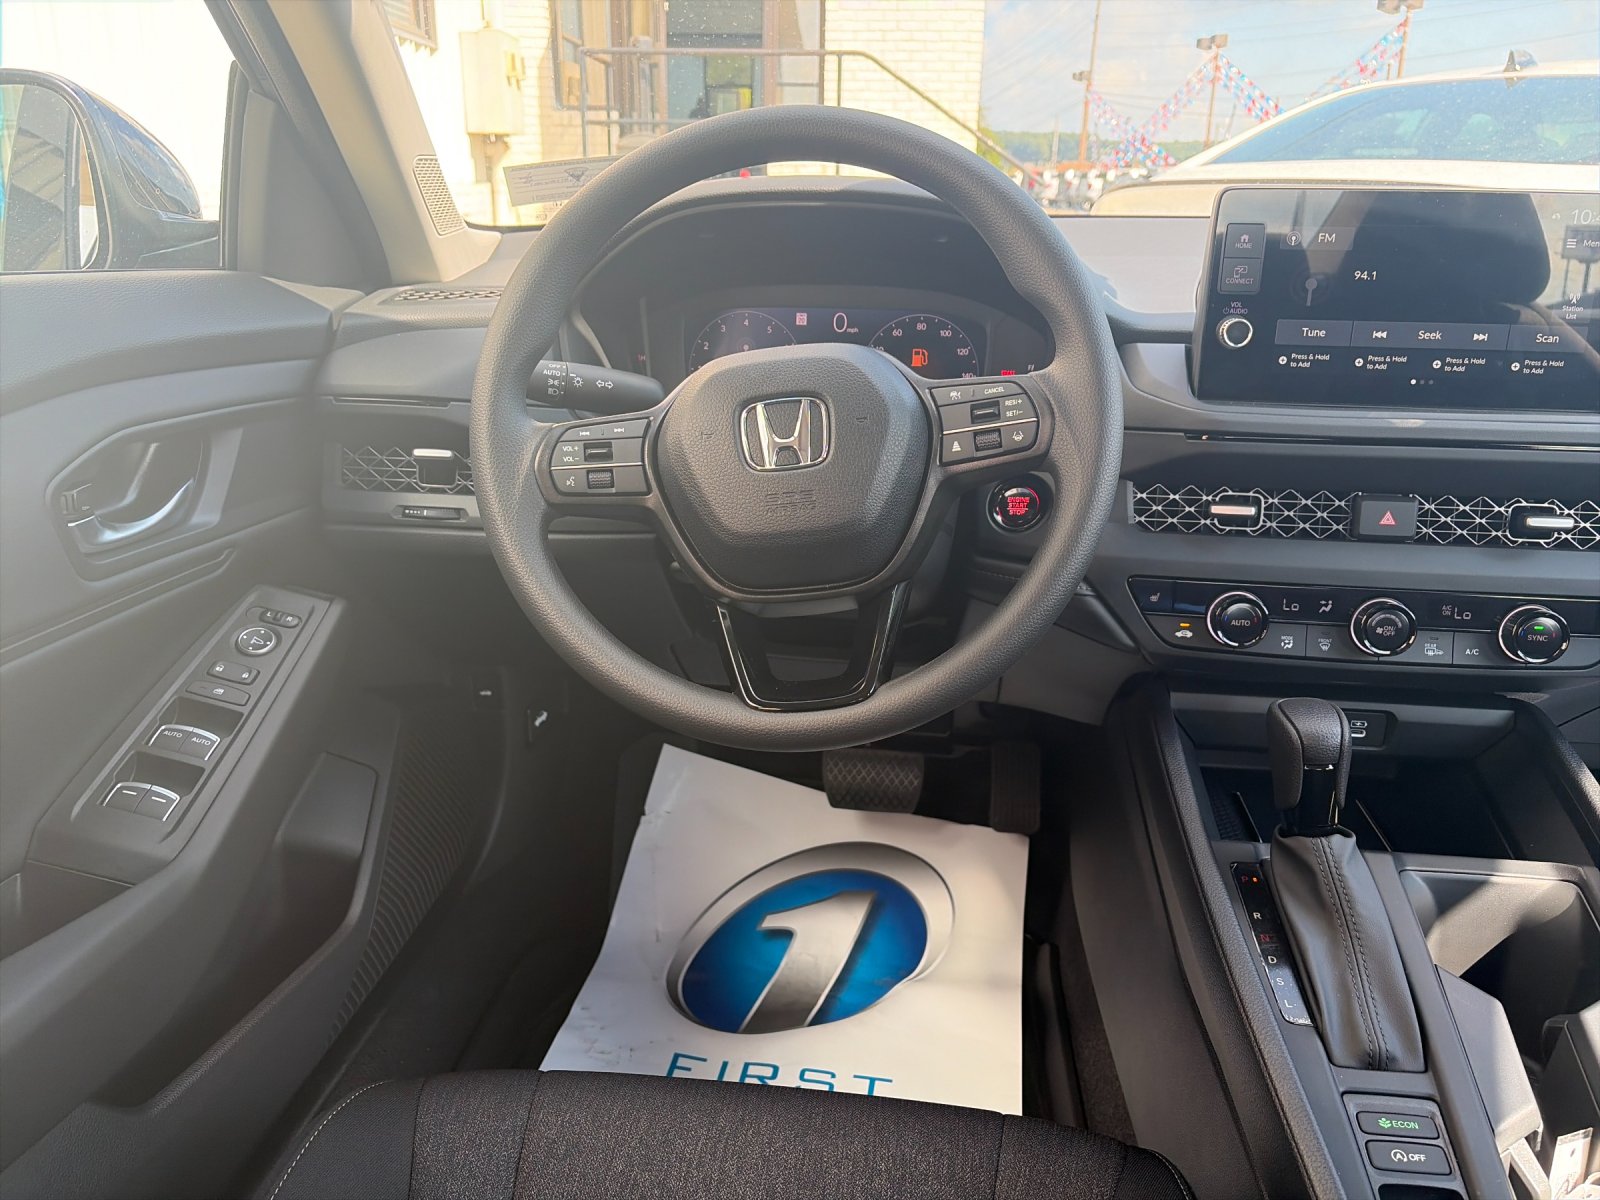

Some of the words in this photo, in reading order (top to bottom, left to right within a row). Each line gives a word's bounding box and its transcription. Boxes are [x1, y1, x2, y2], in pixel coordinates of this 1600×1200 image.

[1318, 233, 1336, 243] FM
[1583, 239, 1600, 247] Men
[1354, 270, 1377, 281] 94.1
[767, 326, 773, 334] 5
[847, 326, 859, 334] mph
[916, 322, 927, 331] 80
[892, 328, 903, 337] 60
[940, 329, 952, 337] 100
[1302, 327, 1326, 337] Tune
[1418, 330, 1442, 340] Seek
[1535, 333, 1560, 343] Scan
[703, 342, 709, 350] 2
[1315, 353, 1330, 361] Hold
[1392, 355, 1407, 363] Hold
[1470, 357, 1486, 365] Hold
[984, 386, 1005, 394] CANCEL
[1282, 598, 1300, 611] Lo
[1454, 607, 1472, 620] Lo
[1527, 634, 1548, 642] SYNC
[1465, 648, 1480, 656] A/C
[163, 730, 183, 738] AUTO
[191, 736, 211, 746] AUTO
[1241, 875, 1249, 883] P
[1253, 912, 1262, 920] R
[1260, 934, 1269, 942] N
[1267, 955, 1277, 965] D
[1276, 977, 1285, 986] S
[1284, 999, 1293, 1008] L
[666, 1052, 893, 1097] FIRST
[1391, 1120, 1420, 1129] ECON
[1408, 1153, 1427, 1162] OFF
